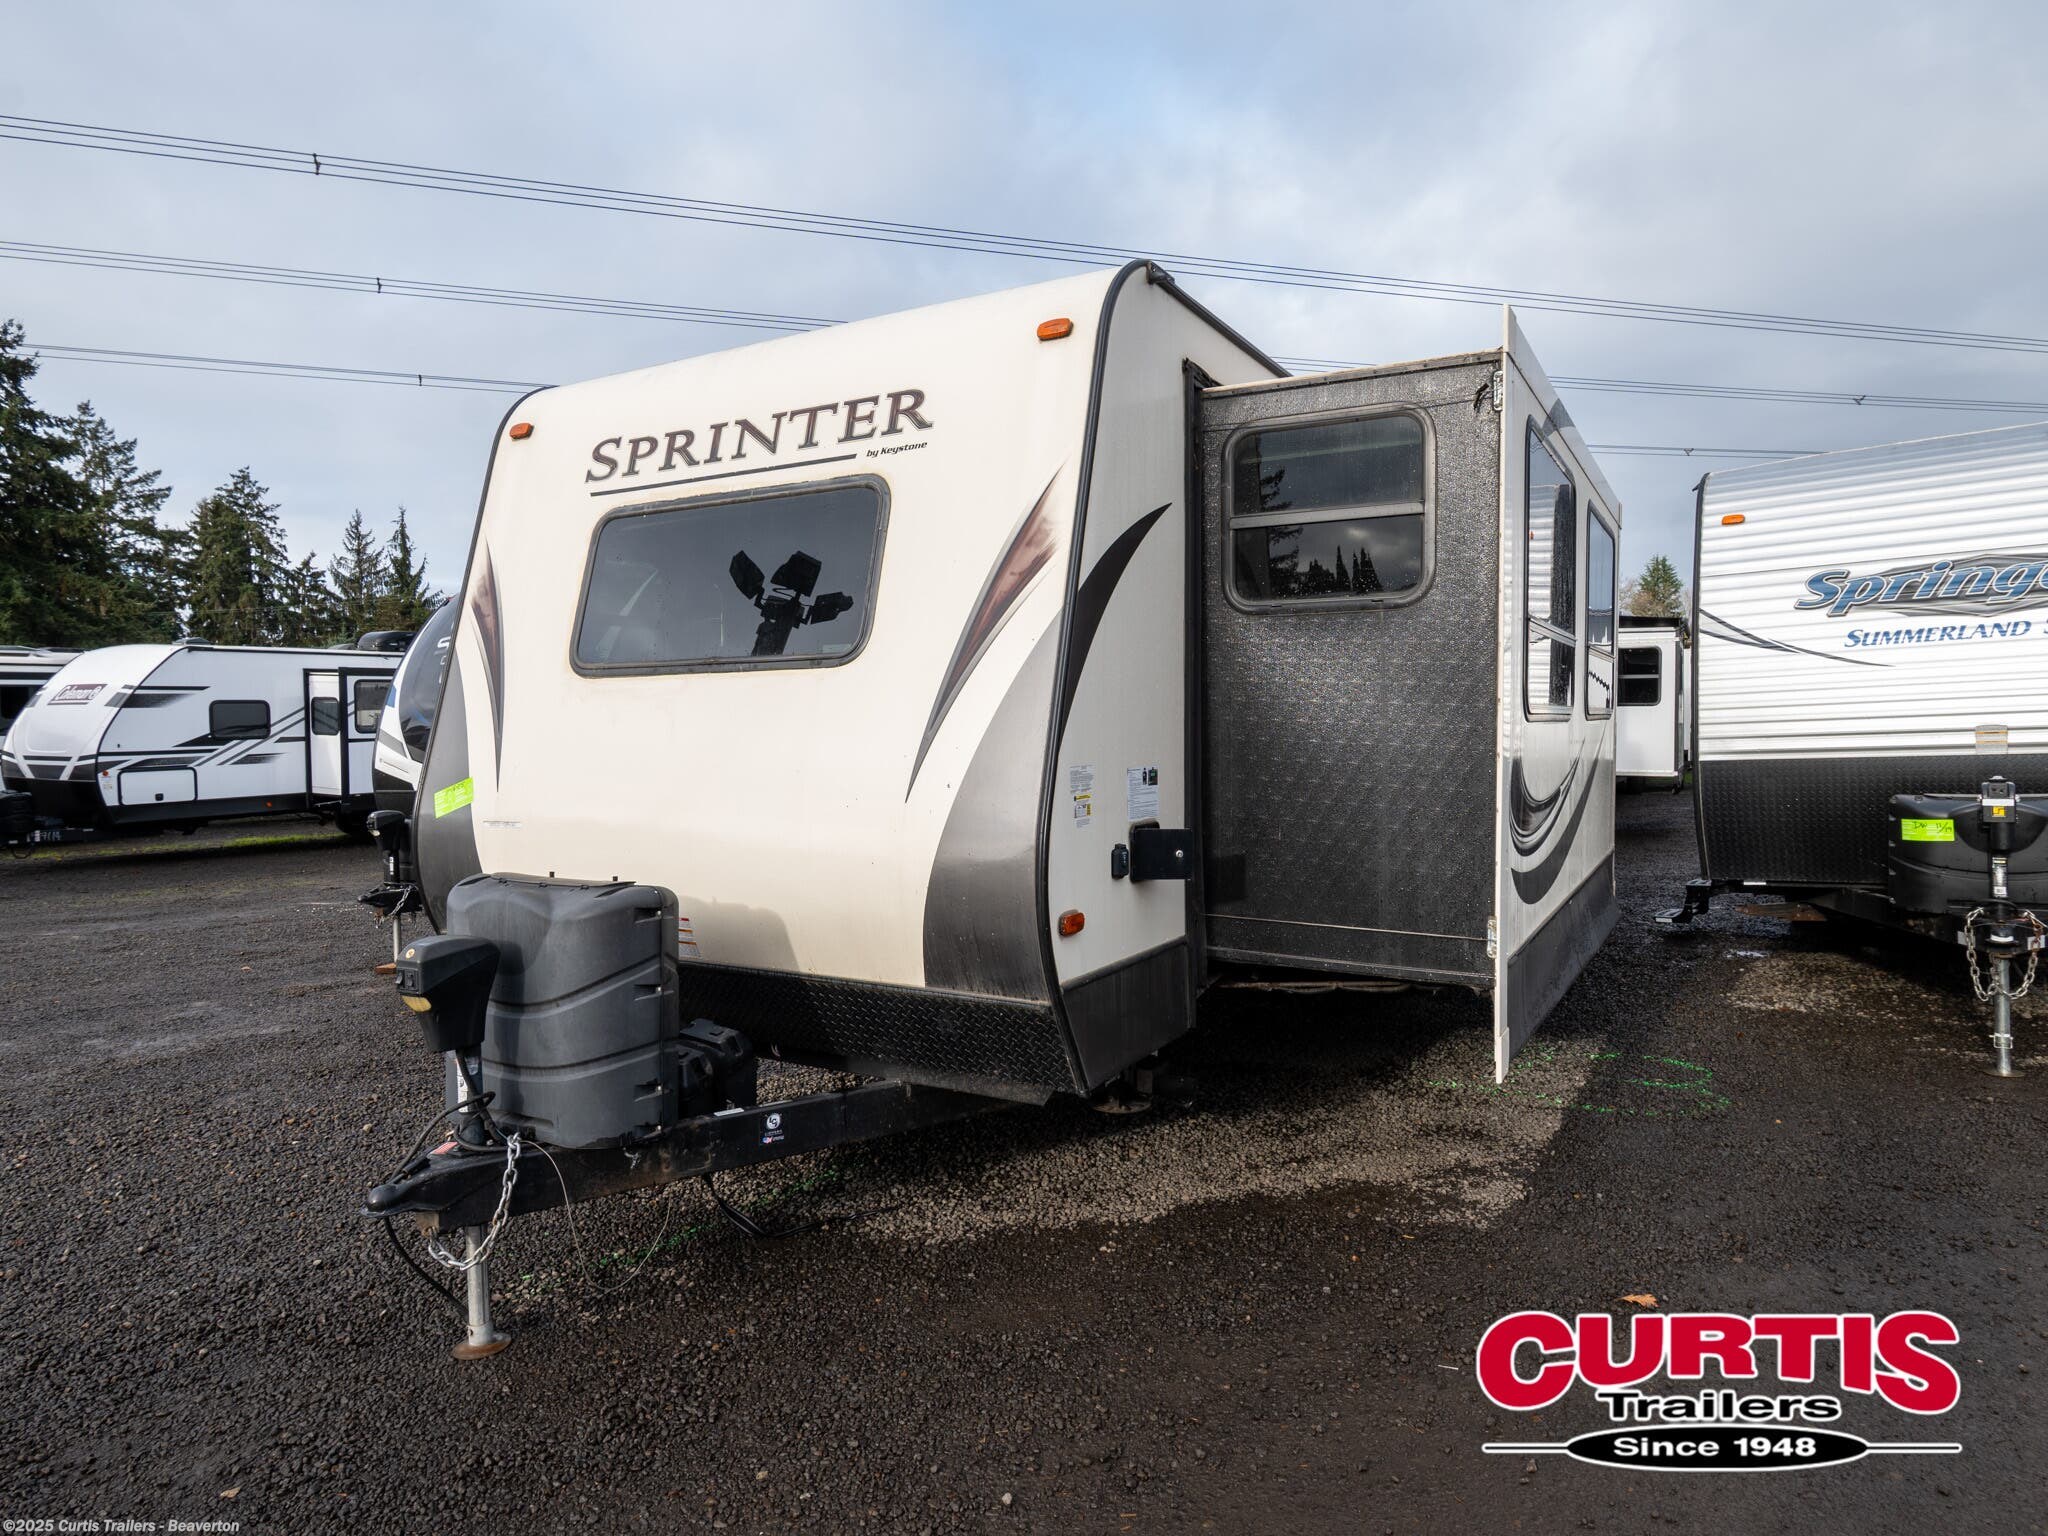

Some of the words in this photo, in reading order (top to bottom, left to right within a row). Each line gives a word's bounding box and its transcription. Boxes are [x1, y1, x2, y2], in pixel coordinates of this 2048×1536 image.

[585, 388, 933, 483] SPRINTER
[866, 449, 879, 459] by
[881, 442, 928, 455] Keystone
[1844, 620, 2032, 648] SUMMERLAND
